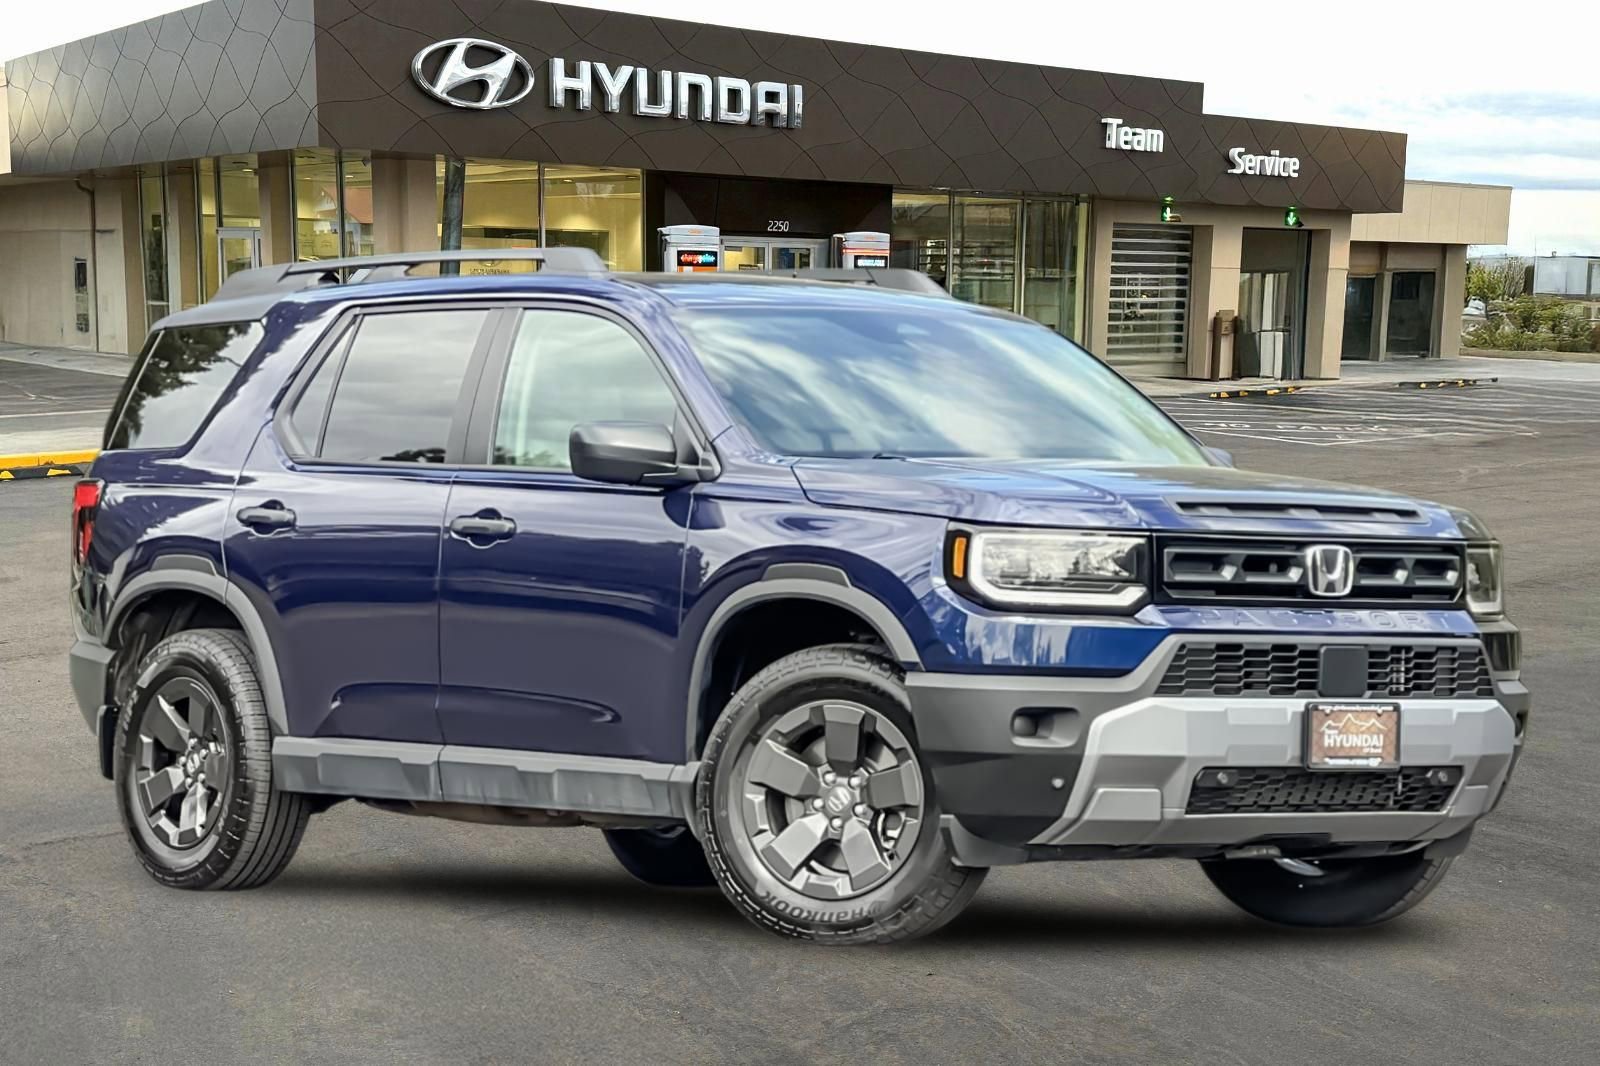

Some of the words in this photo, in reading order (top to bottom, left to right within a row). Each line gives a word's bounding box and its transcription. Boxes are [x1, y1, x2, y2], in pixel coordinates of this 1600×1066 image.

[549, 57, 803, 129] HYUNDAI
[1101, 117, 1164, 153] Team
[1227, 147, 1300, 178] Service
[767, 220, 790, 232] 2250
[1198, 608, 1450, 630] PAPORT
[1323, 734, 1384, 748] HYUNDAI
